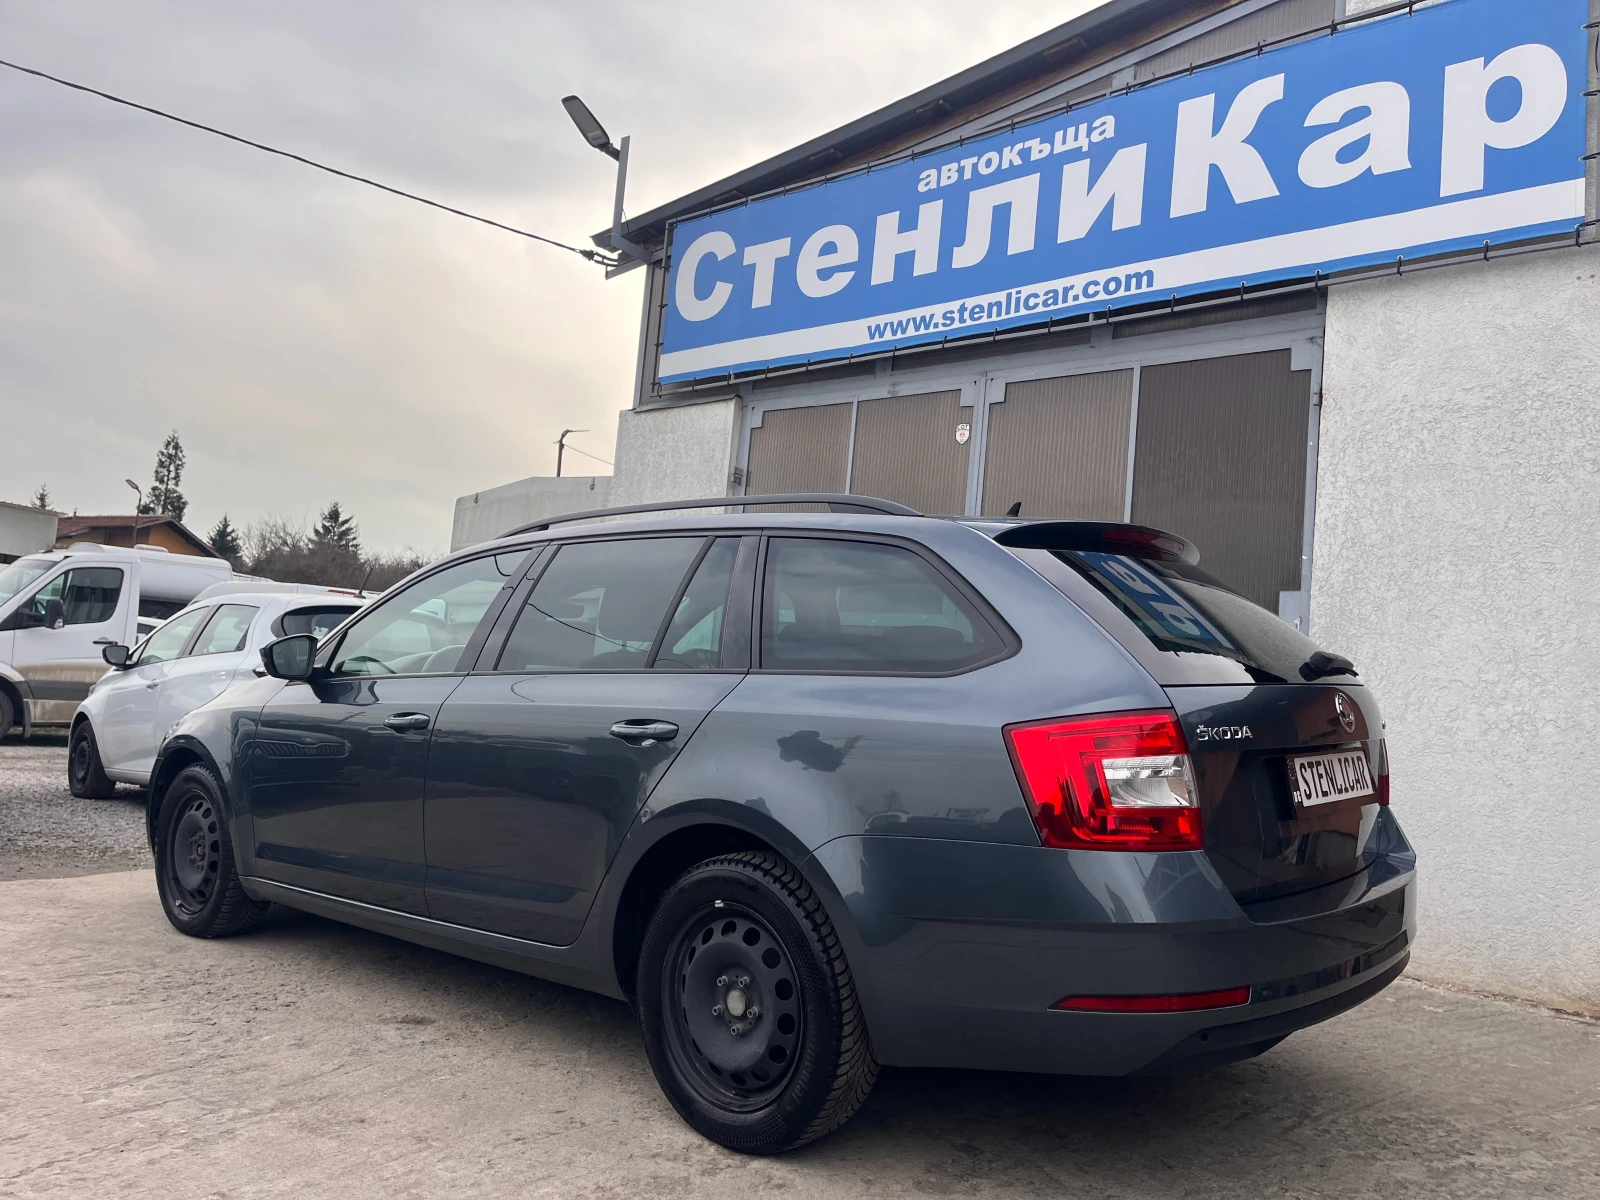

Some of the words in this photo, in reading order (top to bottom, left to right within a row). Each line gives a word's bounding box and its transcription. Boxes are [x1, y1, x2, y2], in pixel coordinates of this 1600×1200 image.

[675, 43, 1568, 322] СтенлиКар
[917, 115, 1116, 193] автокъща
[867, 269, 1155, 341] www.stenlicar.com
[1196, 724, 1253, 741] ŠKODA
[1299, 755, 1369, 800] STENLICAR
